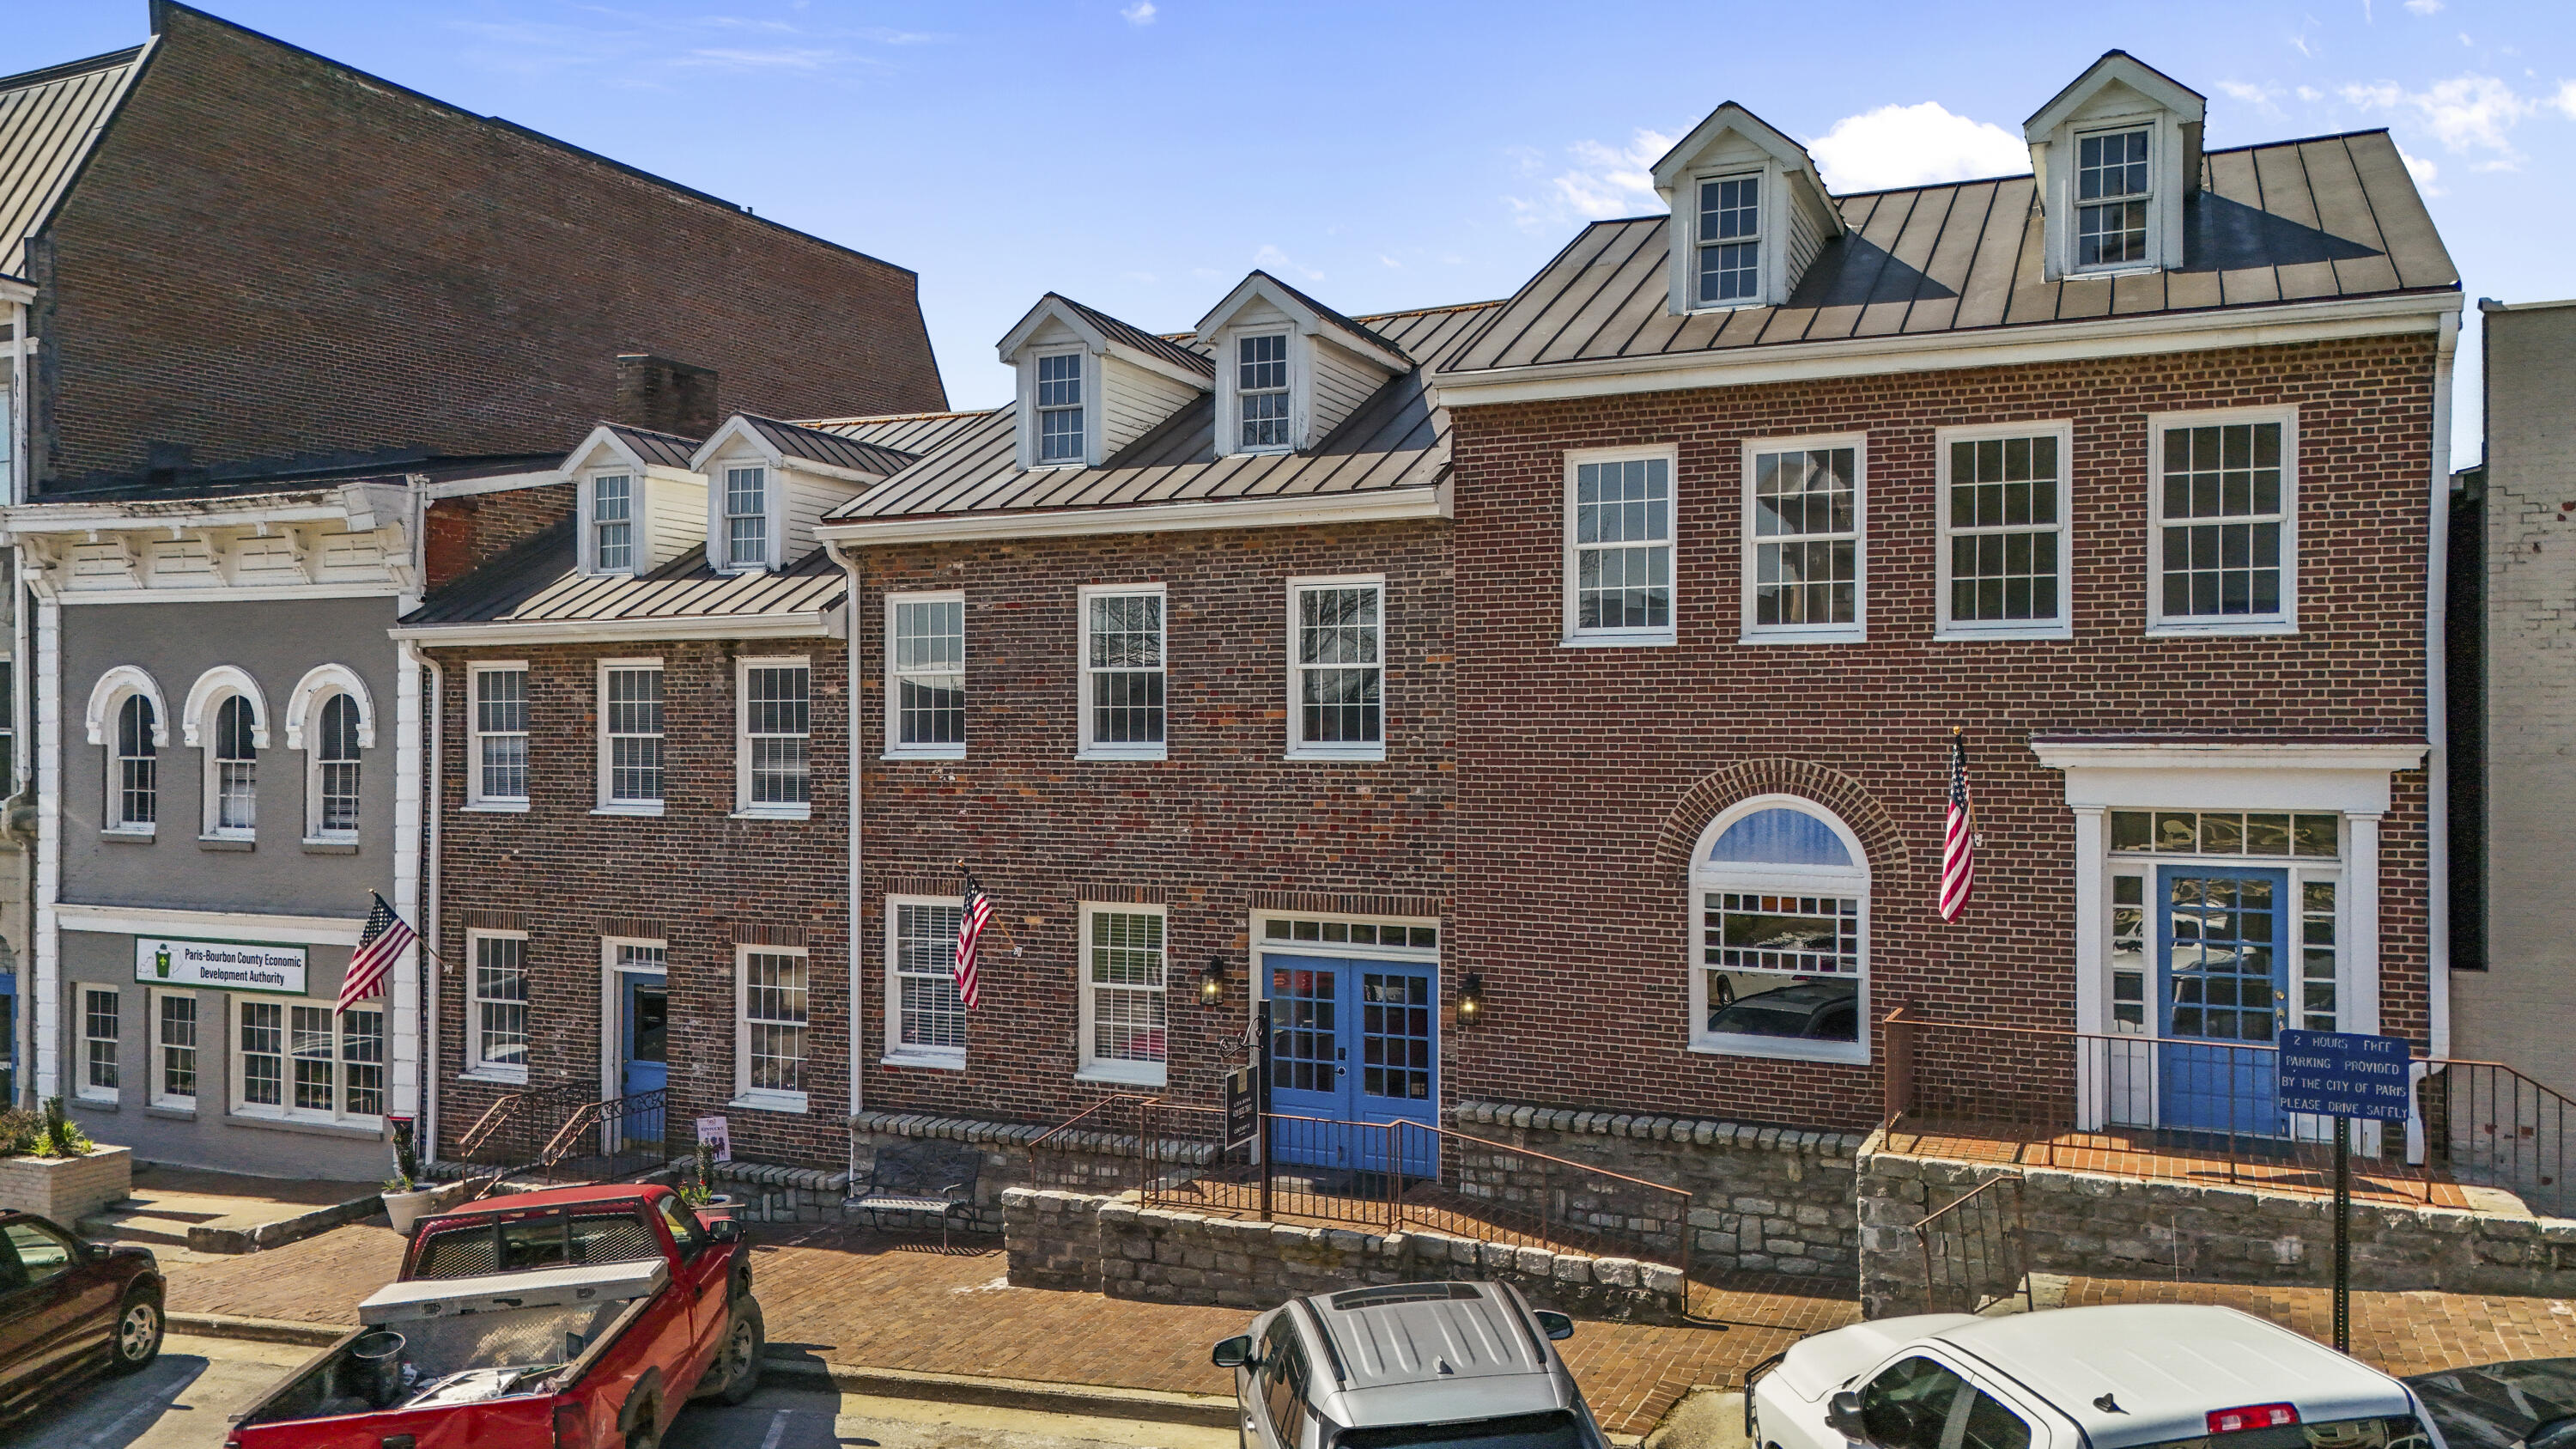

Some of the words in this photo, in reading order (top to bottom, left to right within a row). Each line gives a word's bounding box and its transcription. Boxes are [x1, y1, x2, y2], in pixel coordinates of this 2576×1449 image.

[185, 948, 236, 964] Paris-Bourbon
[237, 952, 263, 968] County
[264, 953, 301, 968] Economic
[200, 966, 248, 982] Development
[249, 971, 284, 986] Authority
[2293, 1035, 2301, 1045] 2
[2312, 1036, 2348, 1049] HOURS
[2286, 1055, 2331, 1068] PARKING
[2344, 1061, 2399, 1075] PROVIDED
[2281, 1076, 2295, 1087] BY
[2301, 1078, 2321, 1089] THE
[2326, 1080, 2348, 1092] CITY
[2354, 1082, 2369, 1093] OF
[2376, 1084, 2406, 1097] PARIS
[2280, 1097, 2321, 1111] PLEASE
[2328, 1101, 2360, 1114] DRIVE
[2366, 1105, 2408, 1119] SAFELY
